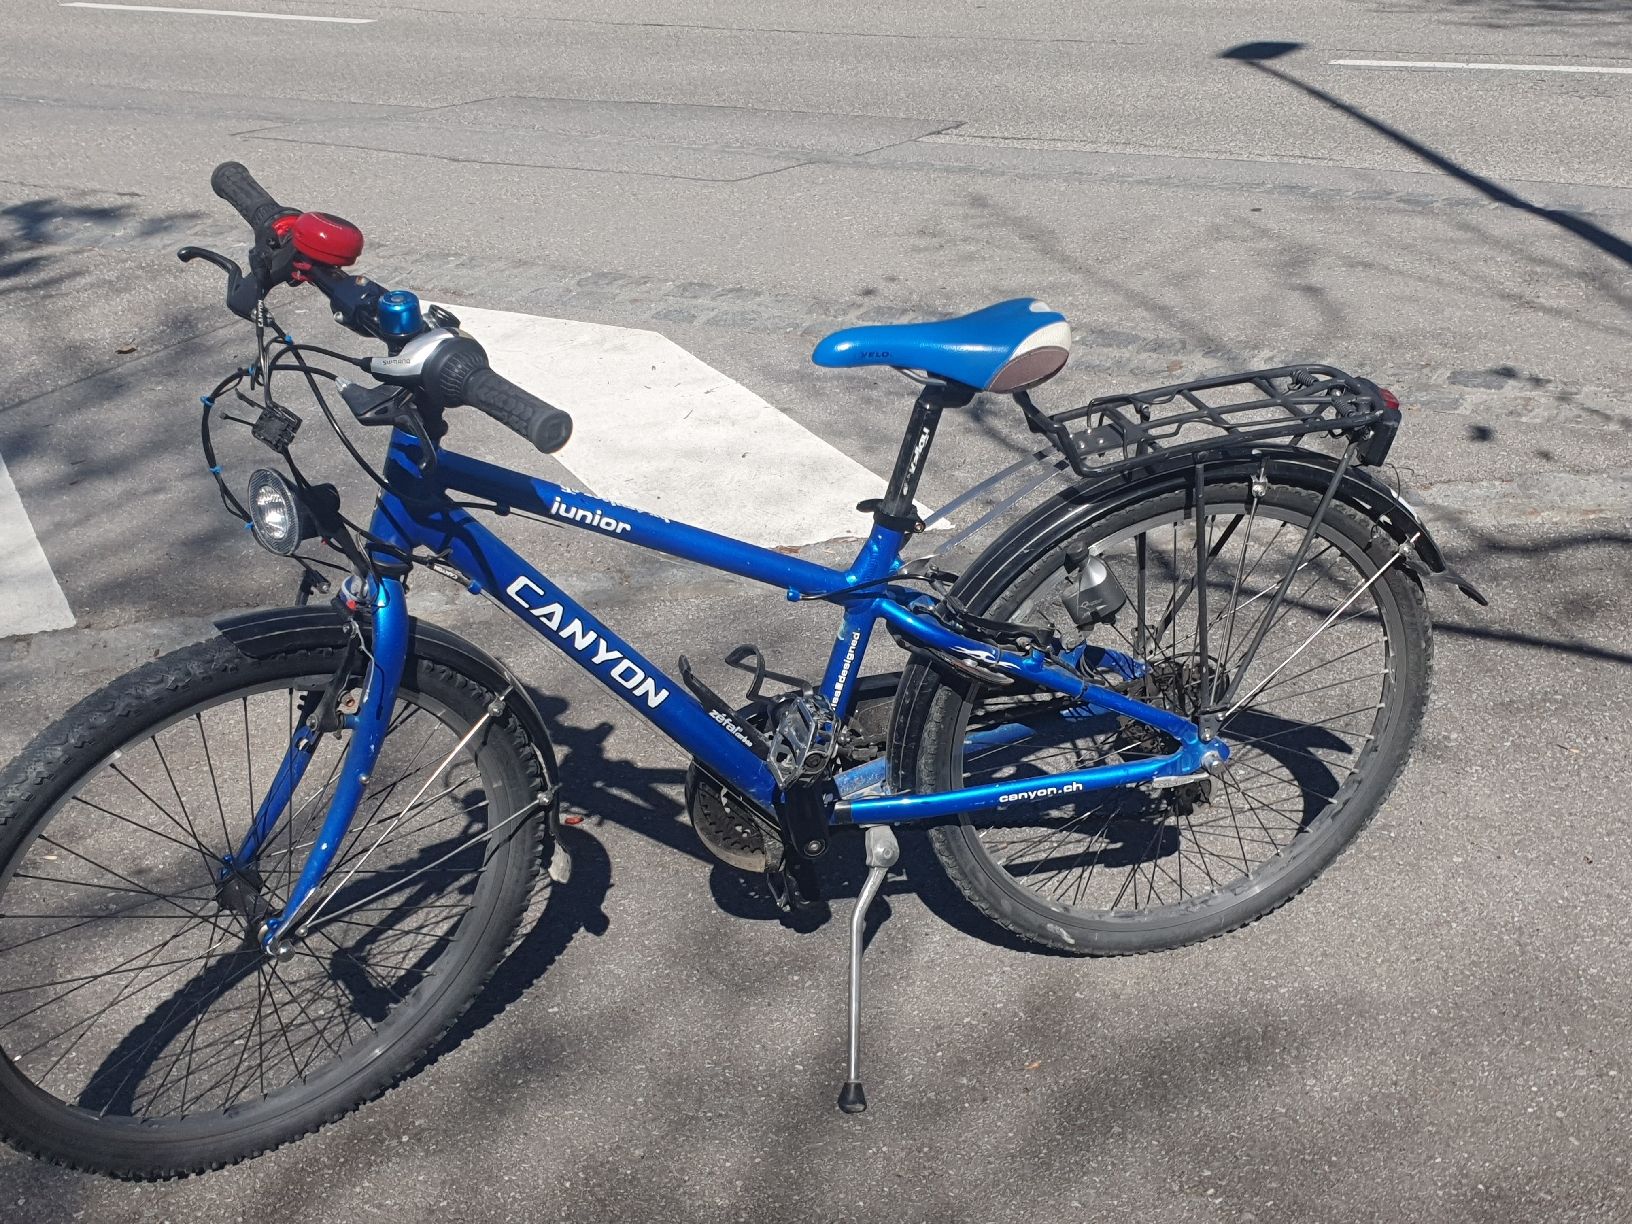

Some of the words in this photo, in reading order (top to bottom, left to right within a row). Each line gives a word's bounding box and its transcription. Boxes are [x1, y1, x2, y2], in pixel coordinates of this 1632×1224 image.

[506, 575, 671, 710] CANYON
[838, 631, 861, 683] designed
[998, 781, 1083, 803] canyon.ch
